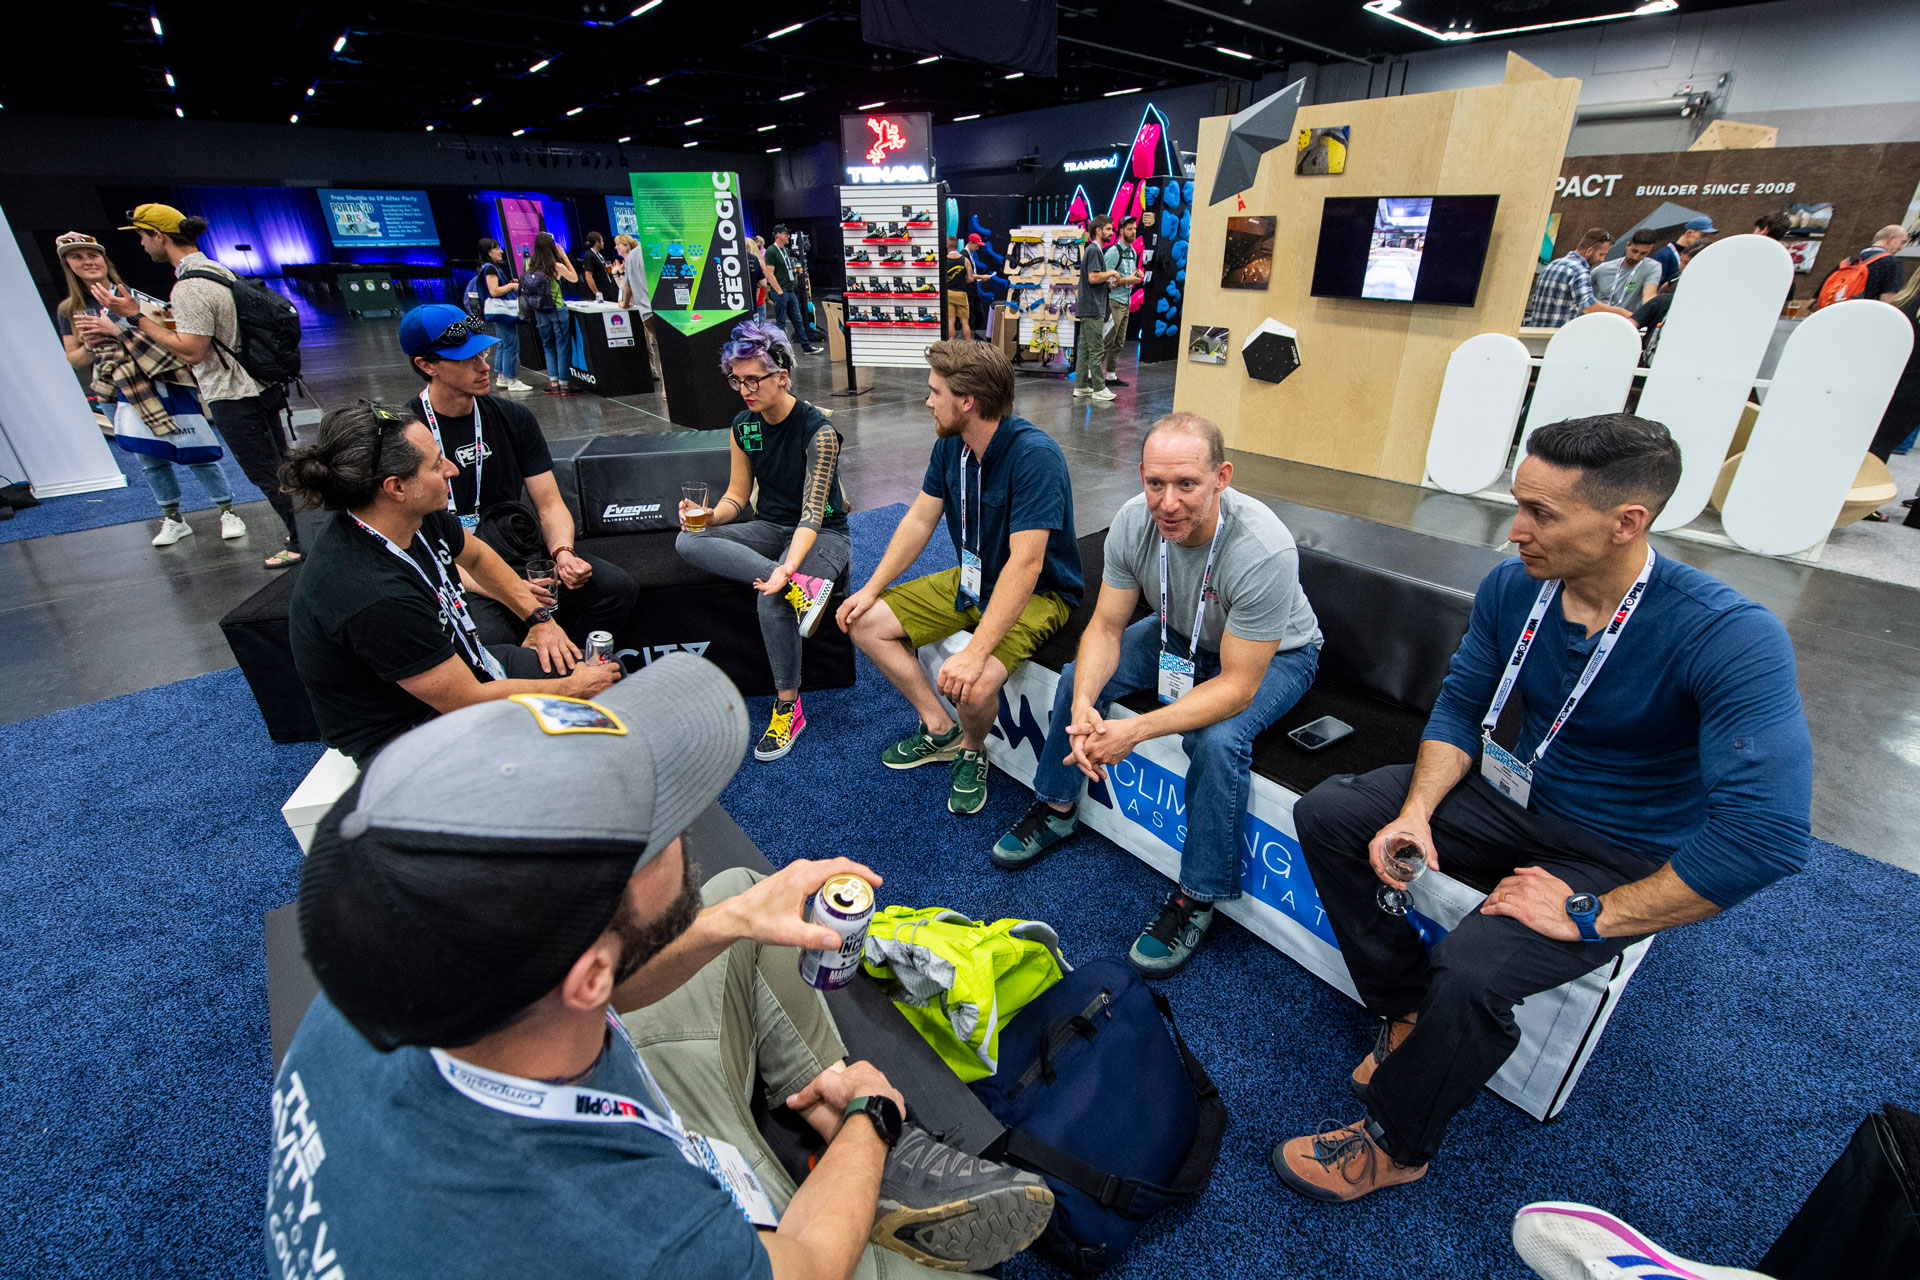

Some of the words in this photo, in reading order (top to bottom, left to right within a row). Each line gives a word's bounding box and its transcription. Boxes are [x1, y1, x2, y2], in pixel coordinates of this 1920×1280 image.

[846, 165, 929, 183] TENAYA
[1063, 159, 1110, 172] TRANGO
[1635, 184, 1698, 197] BUILDER
[1701, 183, 1751, 196] SINCE
[1754, 182, 1796, 195] 2008
[335, 214, 362, 223] PARIS
[712, 172, 745, 310] GEOLOGIC
[716, 263, 726, 304] TRANGO
[569, 367, 596, 384] TRANGO
[1607, 581, 1646, 635] WALLTOPIA
[1511, 618, 1539, 666] WALLTOPIA
[285, 1070, 326, 1178] THE
